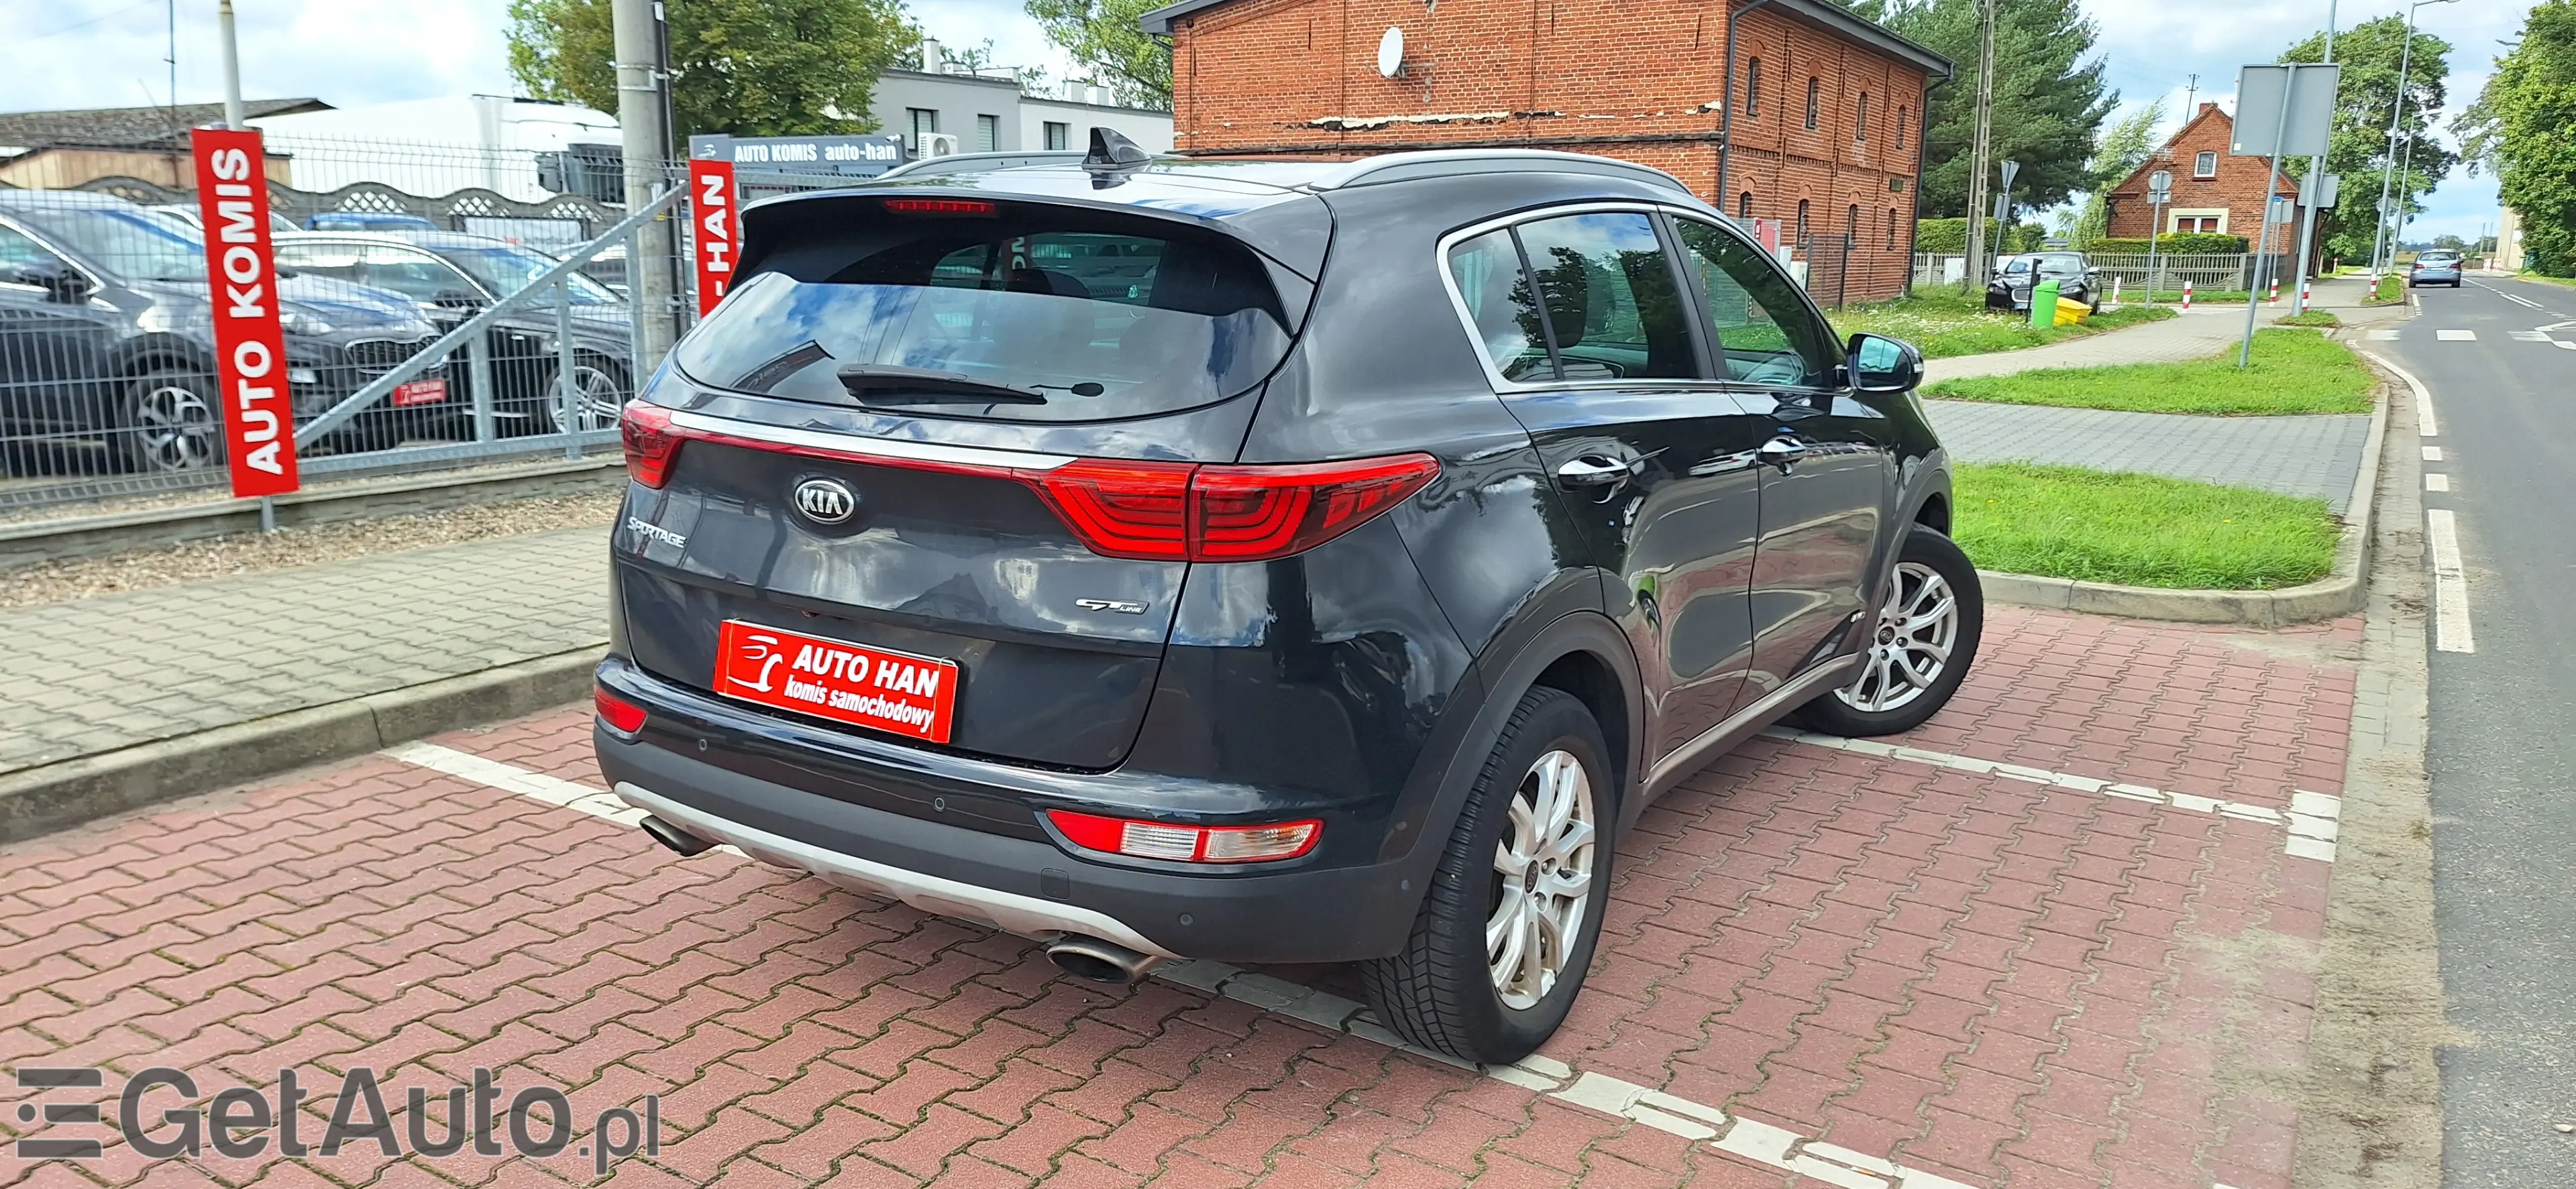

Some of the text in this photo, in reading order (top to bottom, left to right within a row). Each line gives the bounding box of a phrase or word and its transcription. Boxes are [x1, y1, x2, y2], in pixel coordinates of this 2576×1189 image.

[735, 142, 897, 163] AUTO KOMIS auto-han
[700, 174, 730, 272] HAN
[211, 148, 283, 475] AUTO KOMIS
[802, 488, 843, 515] KIA
[627, 516, 687, 549] SPORTAGE
[792, 644, 940, 698] AUTO HAN
[784, 674, 935, 734] komis samochodowy
